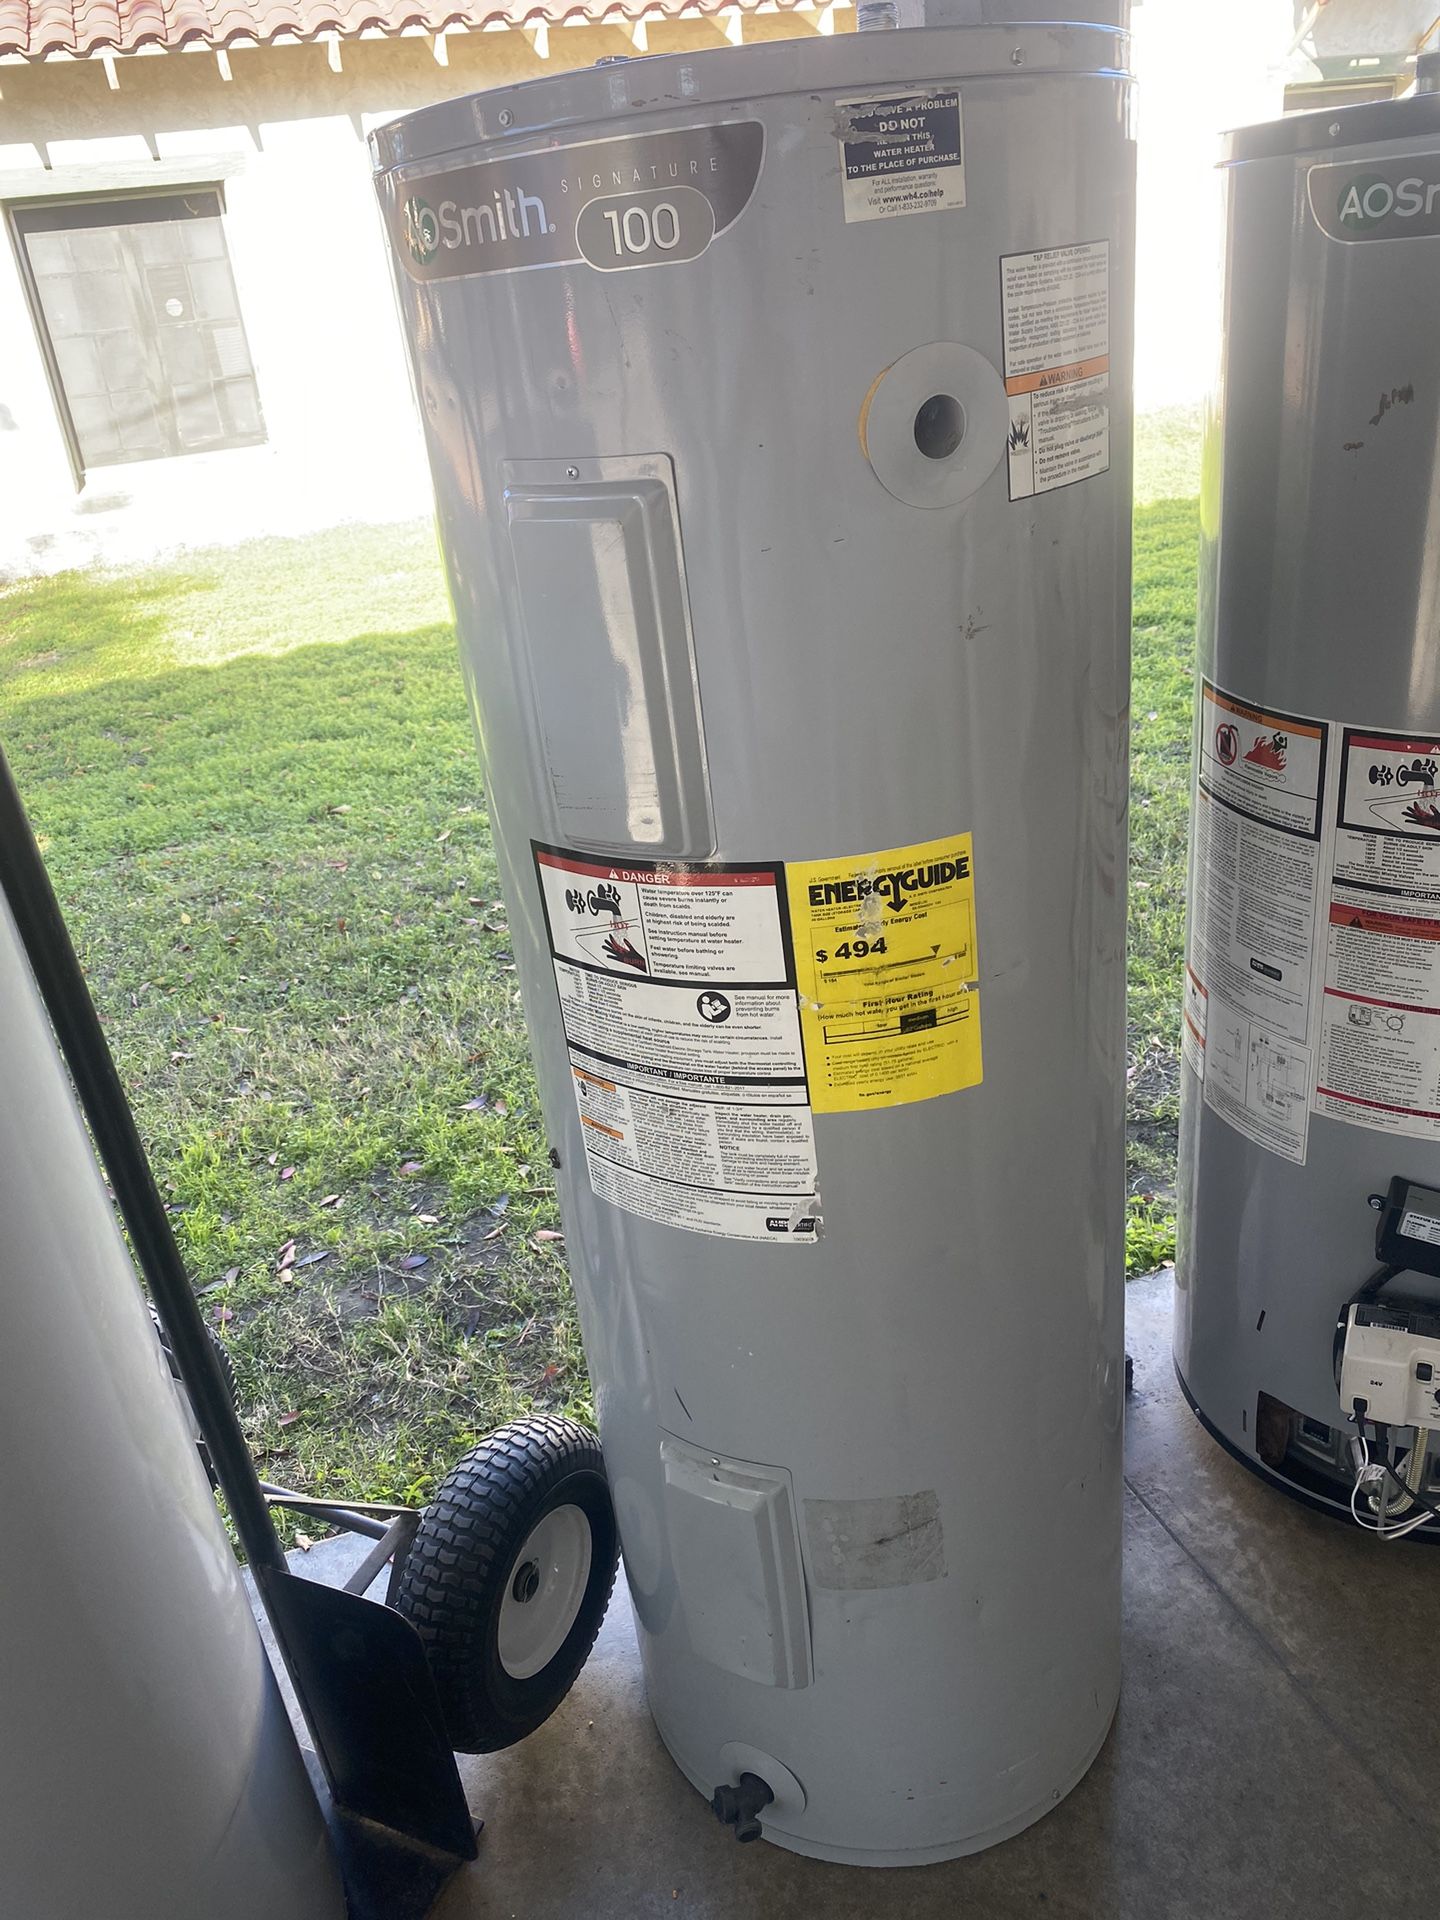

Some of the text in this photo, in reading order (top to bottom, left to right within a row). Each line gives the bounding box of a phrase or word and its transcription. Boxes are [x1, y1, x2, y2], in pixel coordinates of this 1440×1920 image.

[880, 117, 925, 132] DO NOT
[913, 132, 930, 140] THIS
[874, 148, 902, 158] WATER
[848, 153, 960, 174] TO THE PLACE OF PURCHASE.
[560, 157, 719, 193] SIGNATURE
[603, 202, 680, 255] 100
[1048, 367, 1083, 384] WARNING
[622, 871, 670, 884] DANGER
[808, 856, 970, 908] ENERGYGUIDE
[891, 915, 912, 925] Energy
[816, 937, 887, 963] $ 494
[653, 961, 684, 969] Temperature
[885, 995, 904, 1005] Hour
[907, 990, 933, 1000] Rating
[899, 1003, 909, 1011] get
[929, 995, 941, 1003] first
[942, 992, 955, 1000] hour
[627, 1063, 667, 1077] IMPORTANT
[674, 1072, 725, 1084] IMPORTANTE
